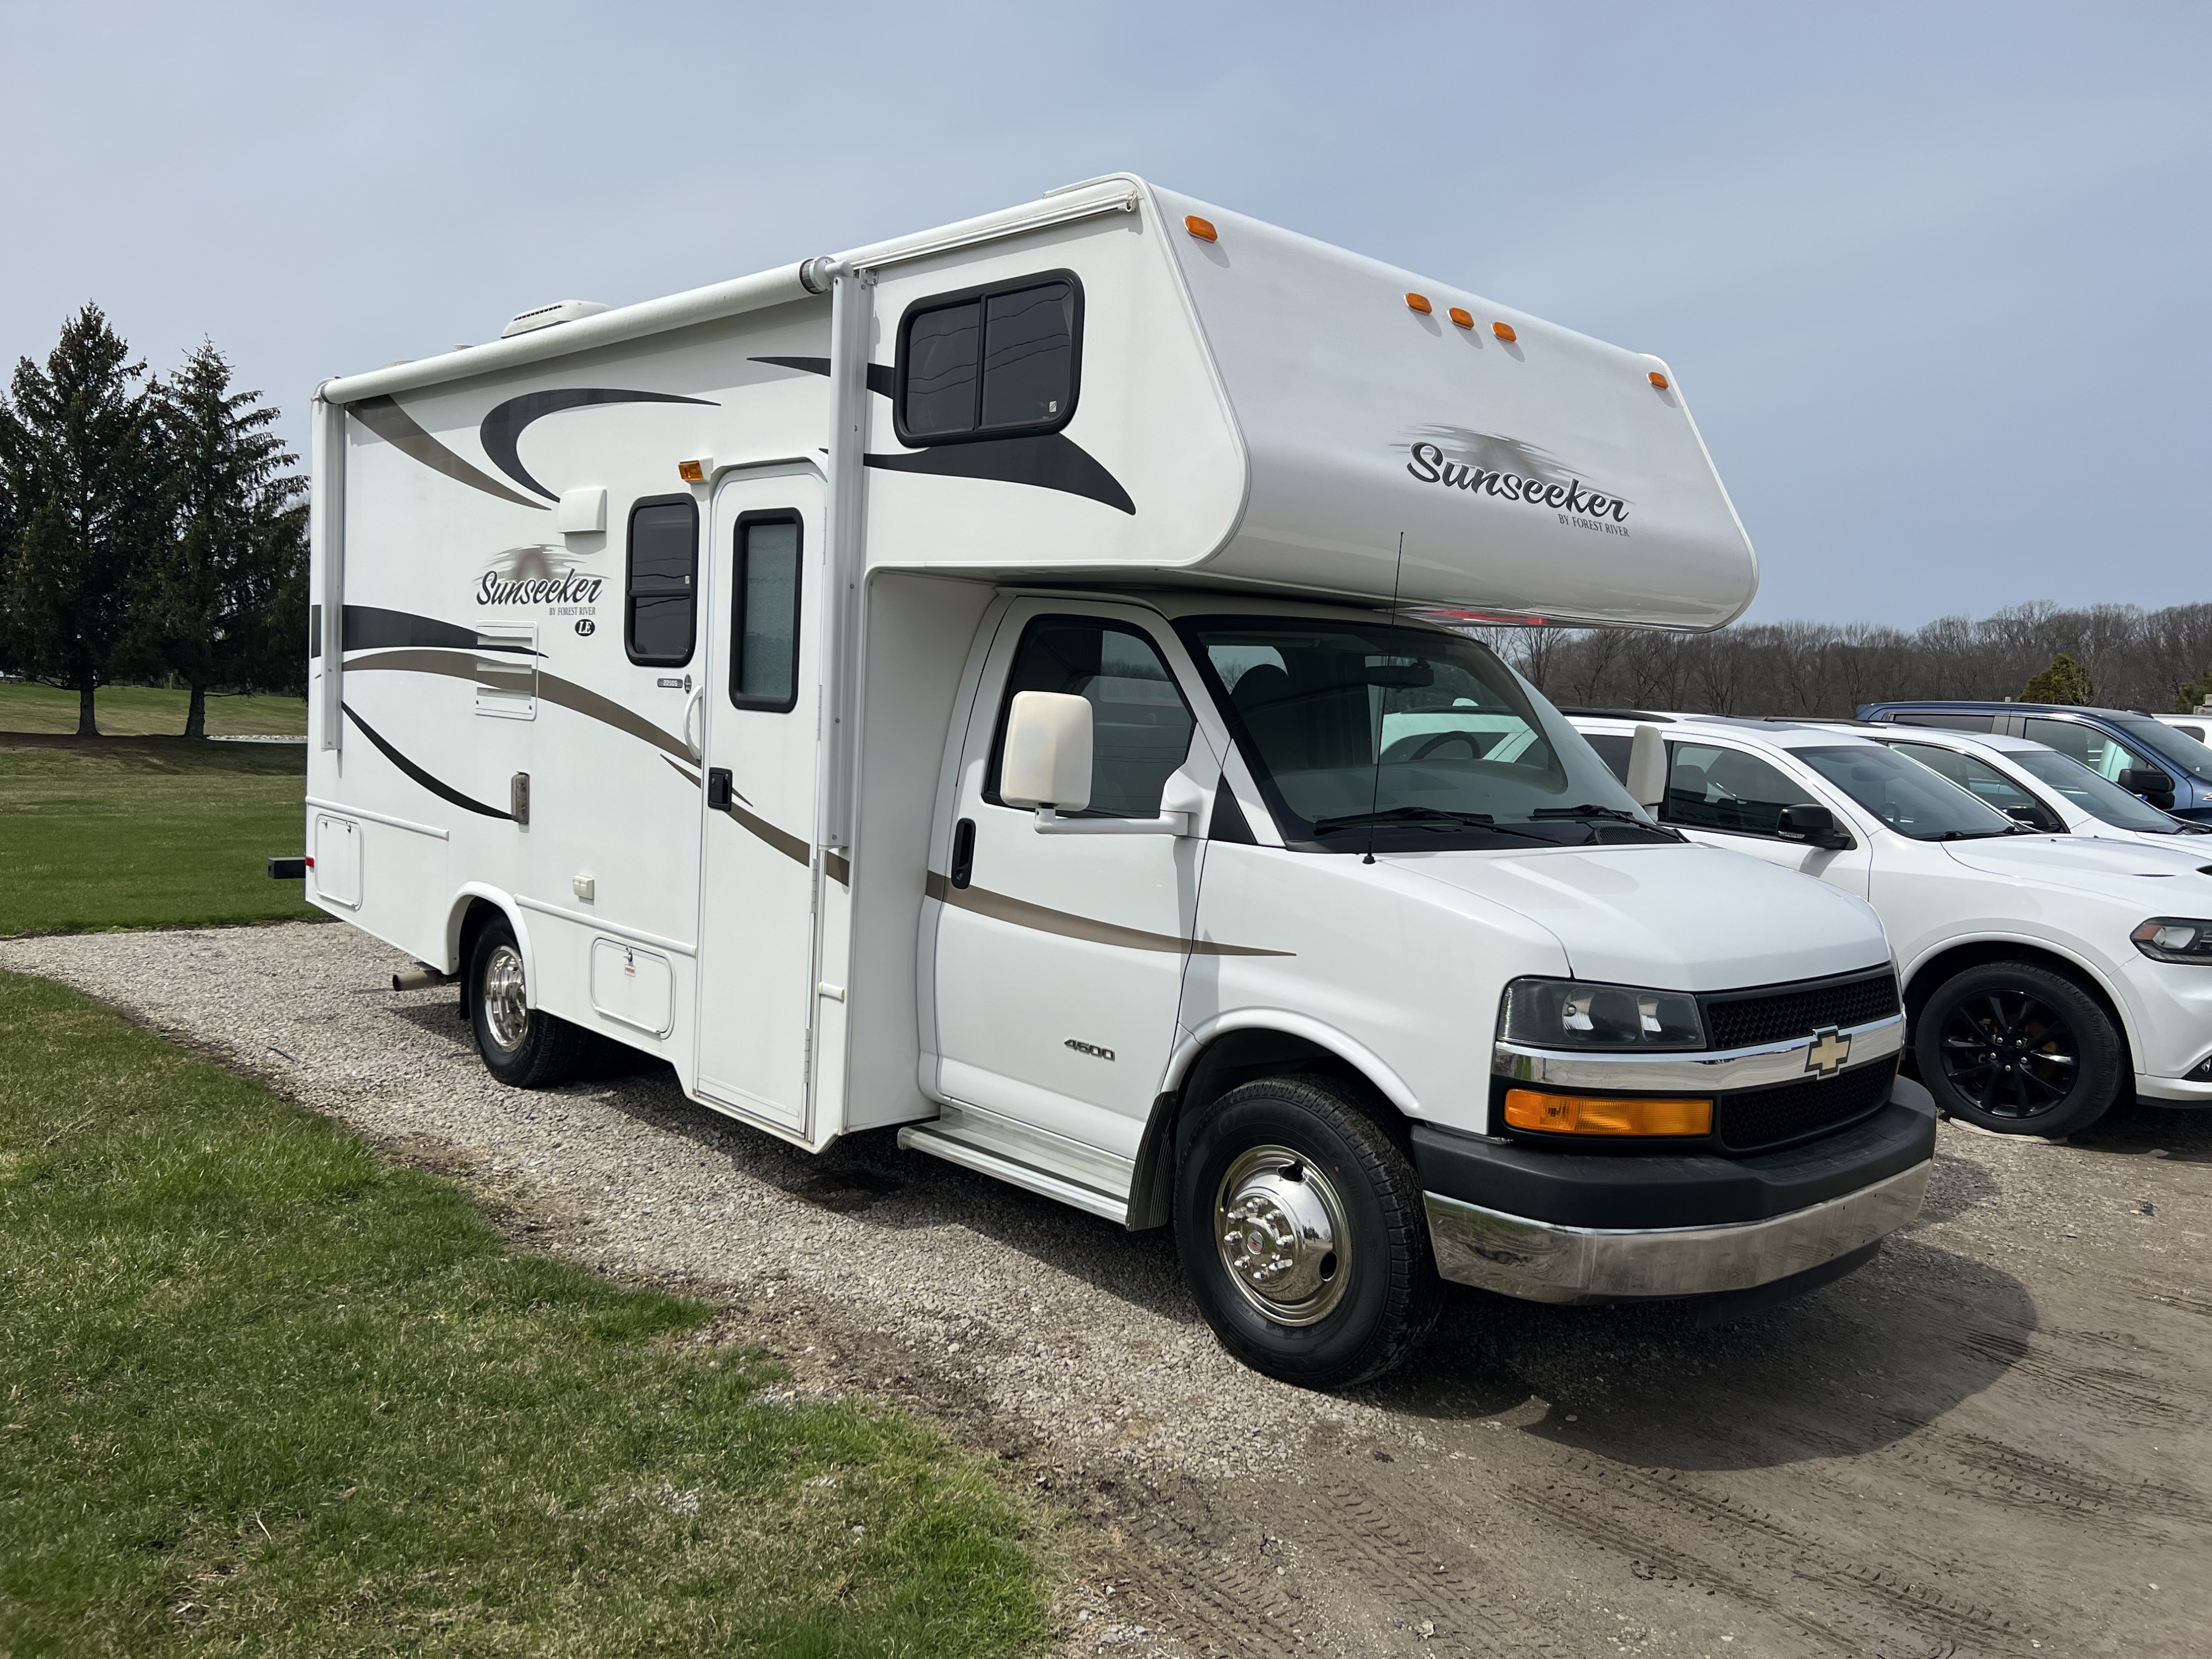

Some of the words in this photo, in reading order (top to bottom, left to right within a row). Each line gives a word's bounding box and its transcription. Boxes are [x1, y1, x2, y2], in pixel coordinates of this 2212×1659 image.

[1407, 442, 1629, 522] Sunseeker
[1558, 514, 1569, 525] BY
[1572, 517, 1603, 533] FOREST
[1605, 523, 1630, 537] RIVER
[477, 568, 603, 605] Sunseeker
[549, 607, 556, 615] BY
[557, 607, 578, 615] FOREST
[579, 607, 596, 615] RIVER
[578, 621, 592, 634] LE
[1064, 1039, 1115, 1062] 4500
